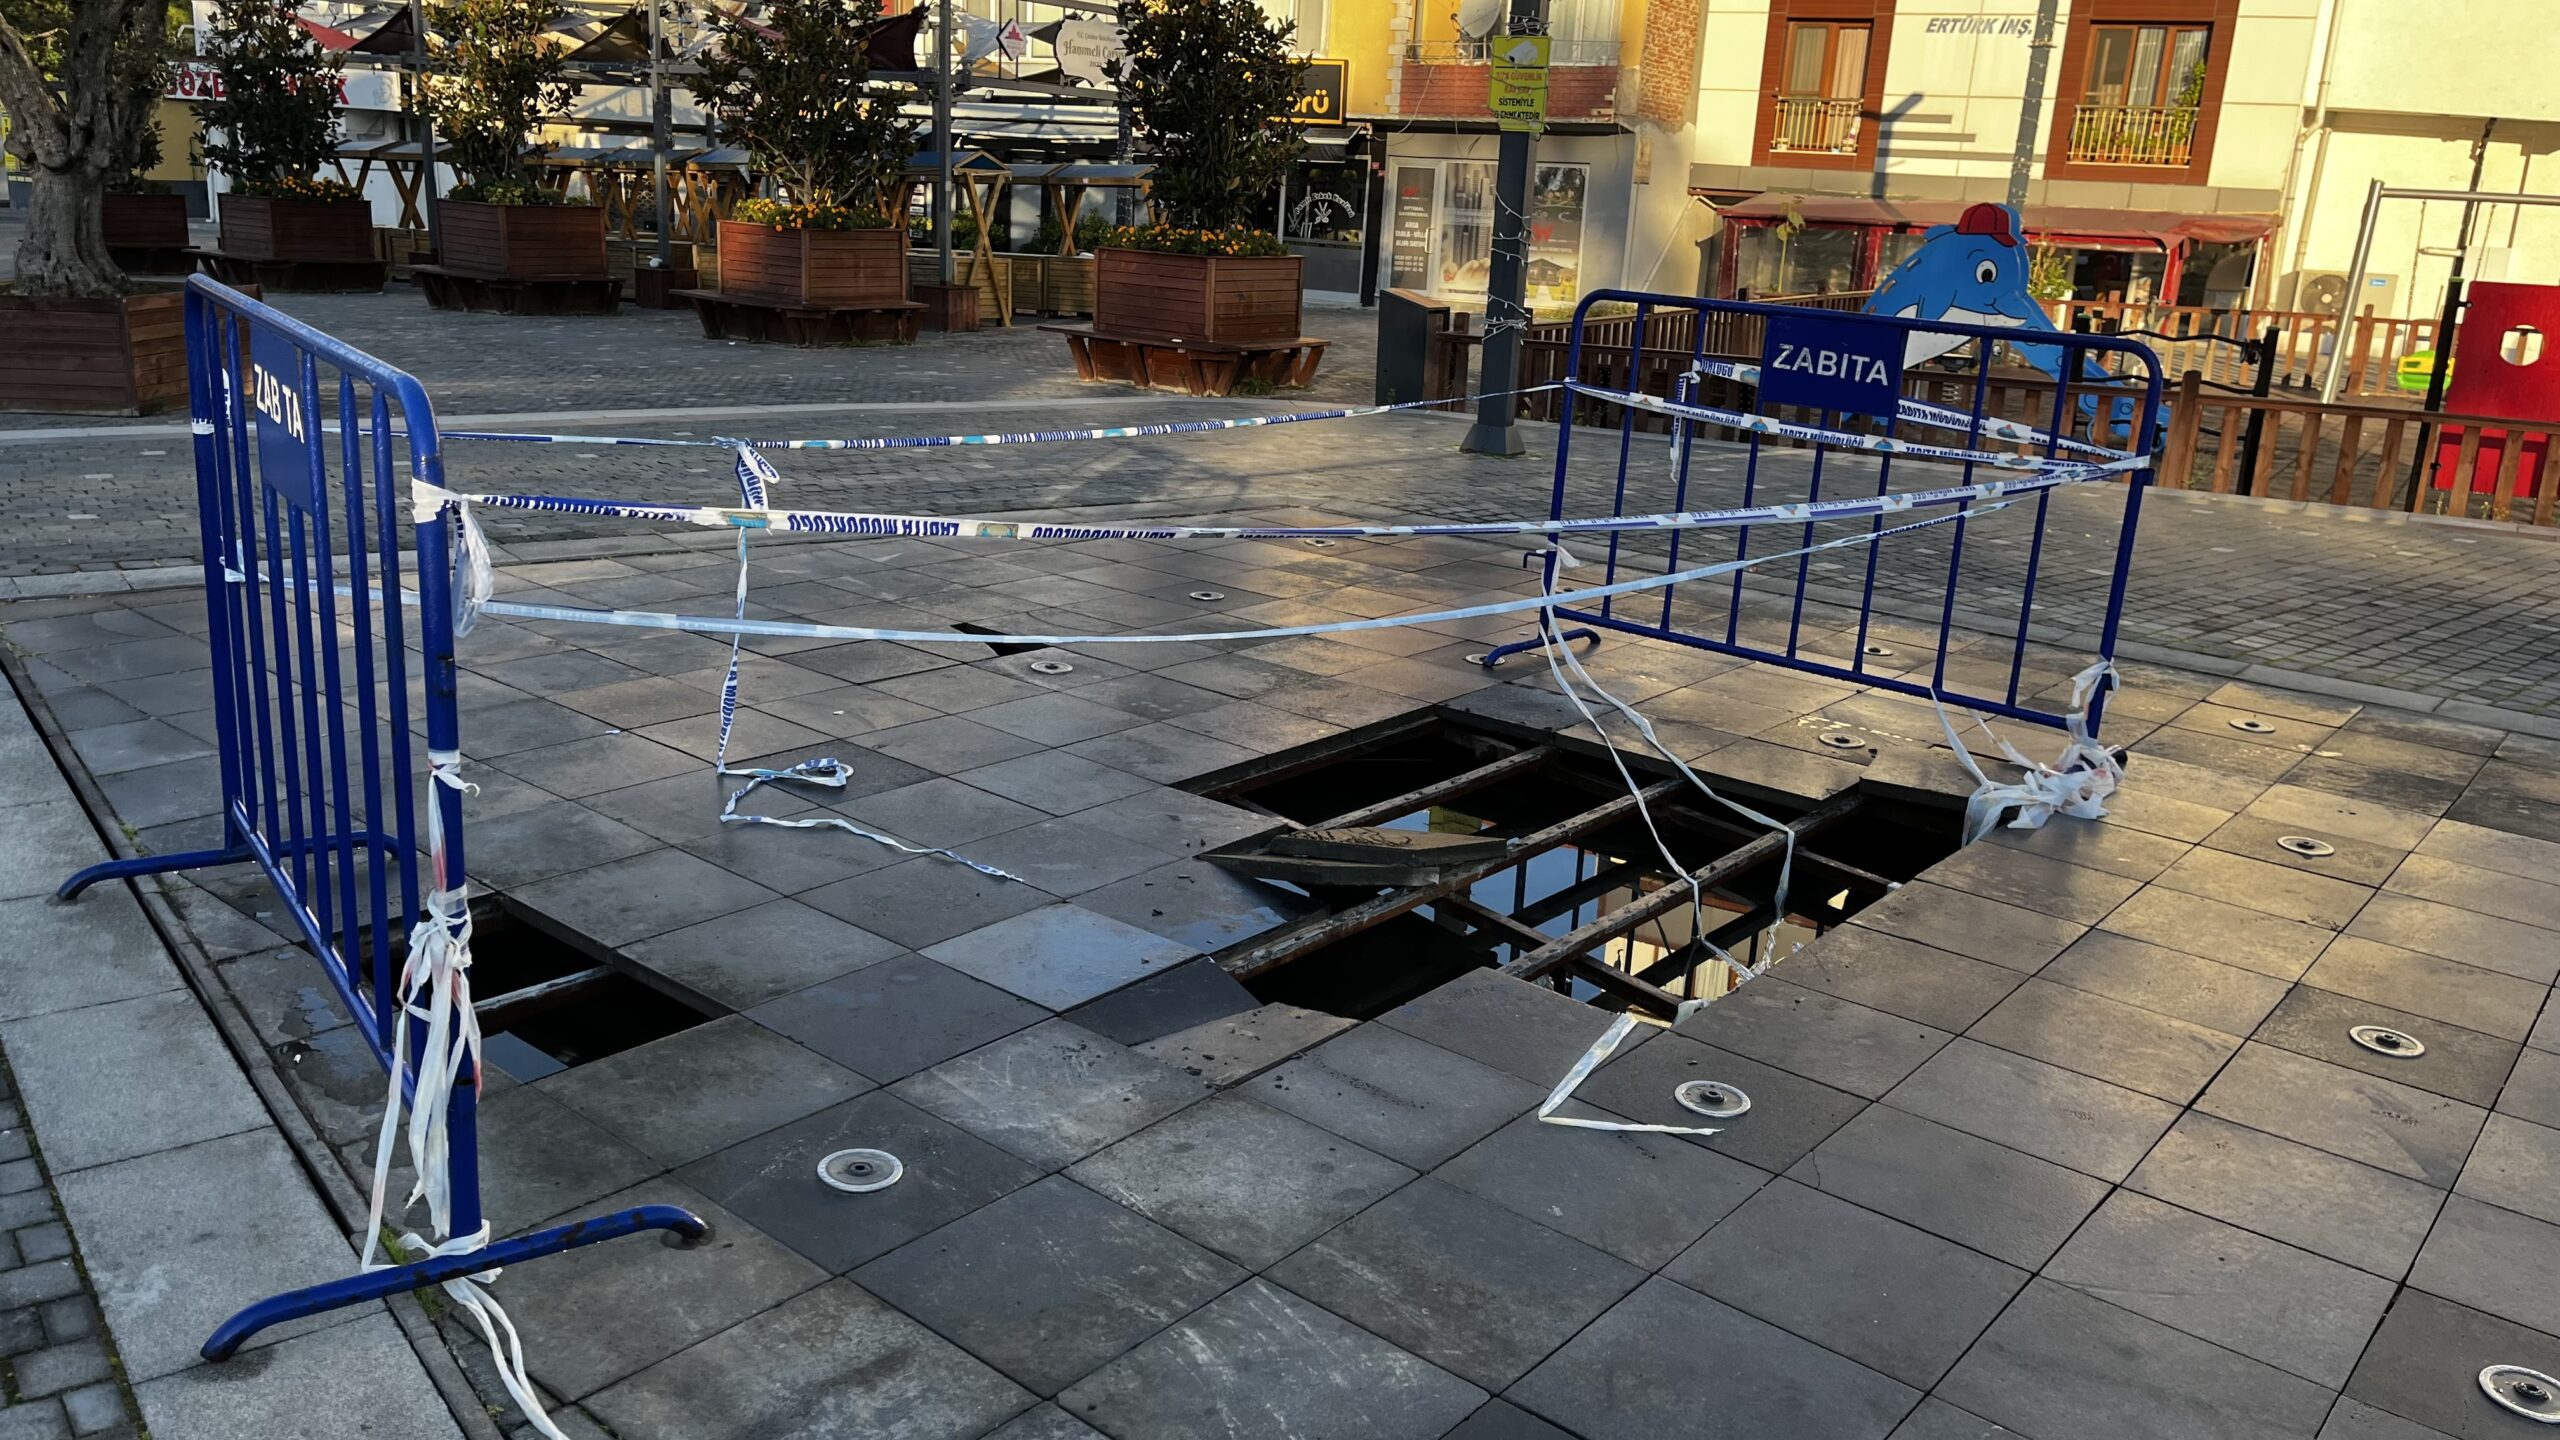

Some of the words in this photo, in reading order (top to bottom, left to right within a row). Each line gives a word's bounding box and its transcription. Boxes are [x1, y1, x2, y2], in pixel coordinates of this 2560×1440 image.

[1925, 14, 1999, 34] ERTÜRK
[1498, 97, 1535, 107] SİSTEMİYLE
[1772, 343, 1889, 386] ZABITA
[254, 363, 304, 444] ZABTA
